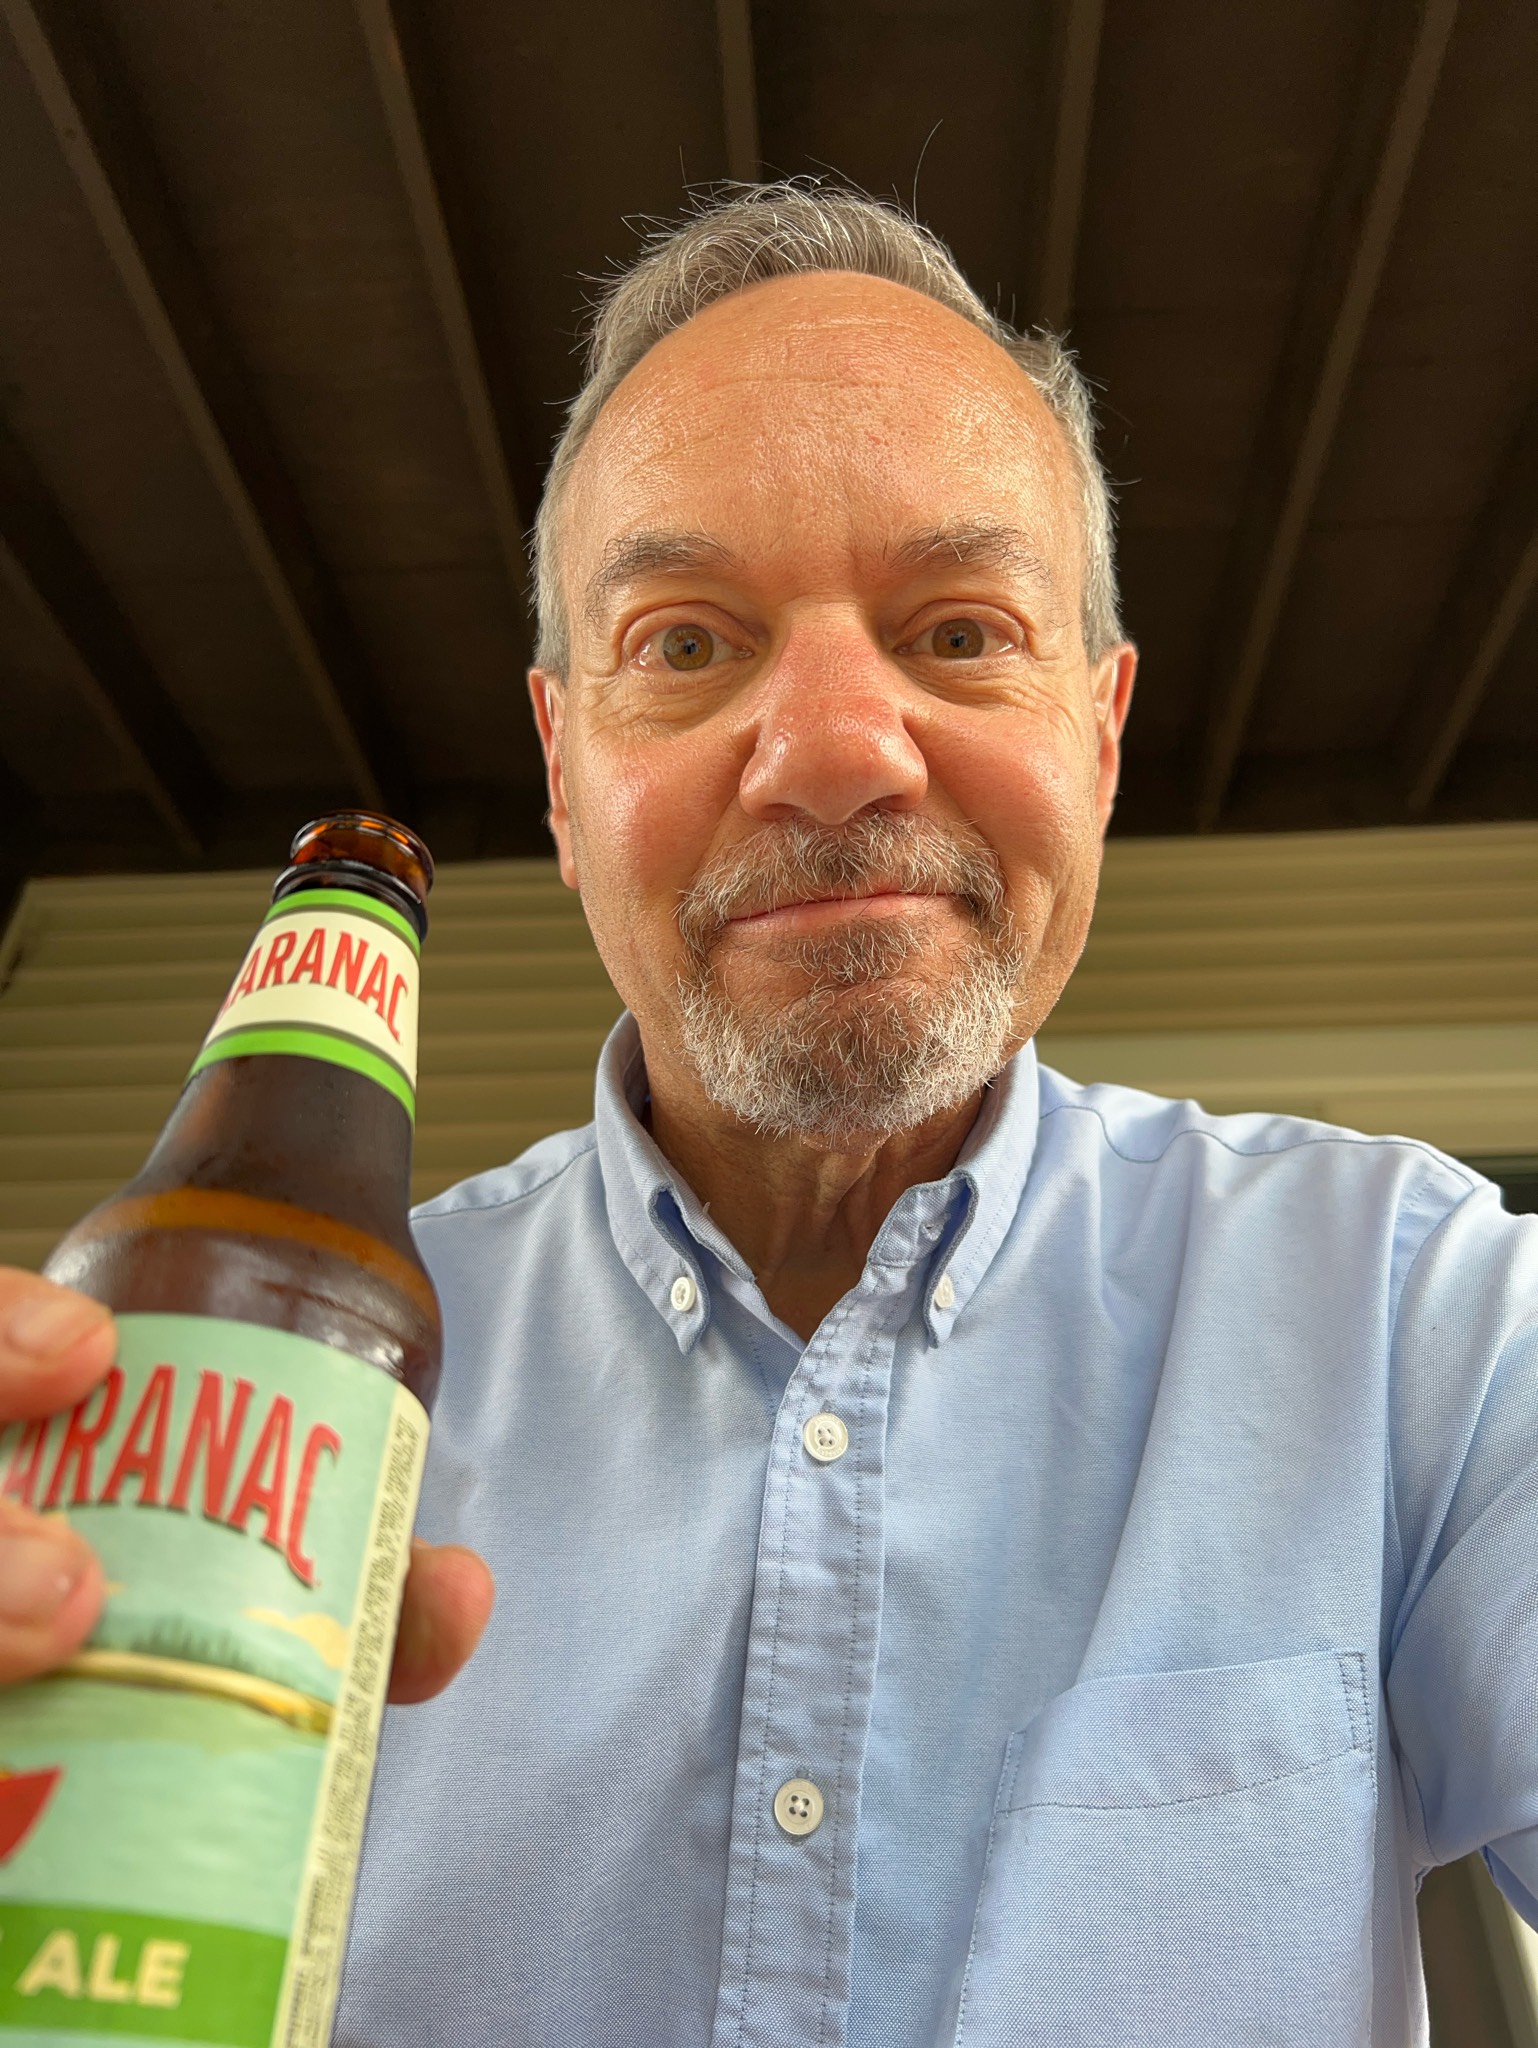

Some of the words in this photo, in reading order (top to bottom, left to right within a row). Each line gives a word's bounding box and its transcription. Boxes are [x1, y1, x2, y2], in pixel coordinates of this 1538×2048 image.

[216, 927, 410, 1046] ARANAC
[0, 1364, 343, 1590] ARANAC
[14, 1929, 191, 2009] ALE
